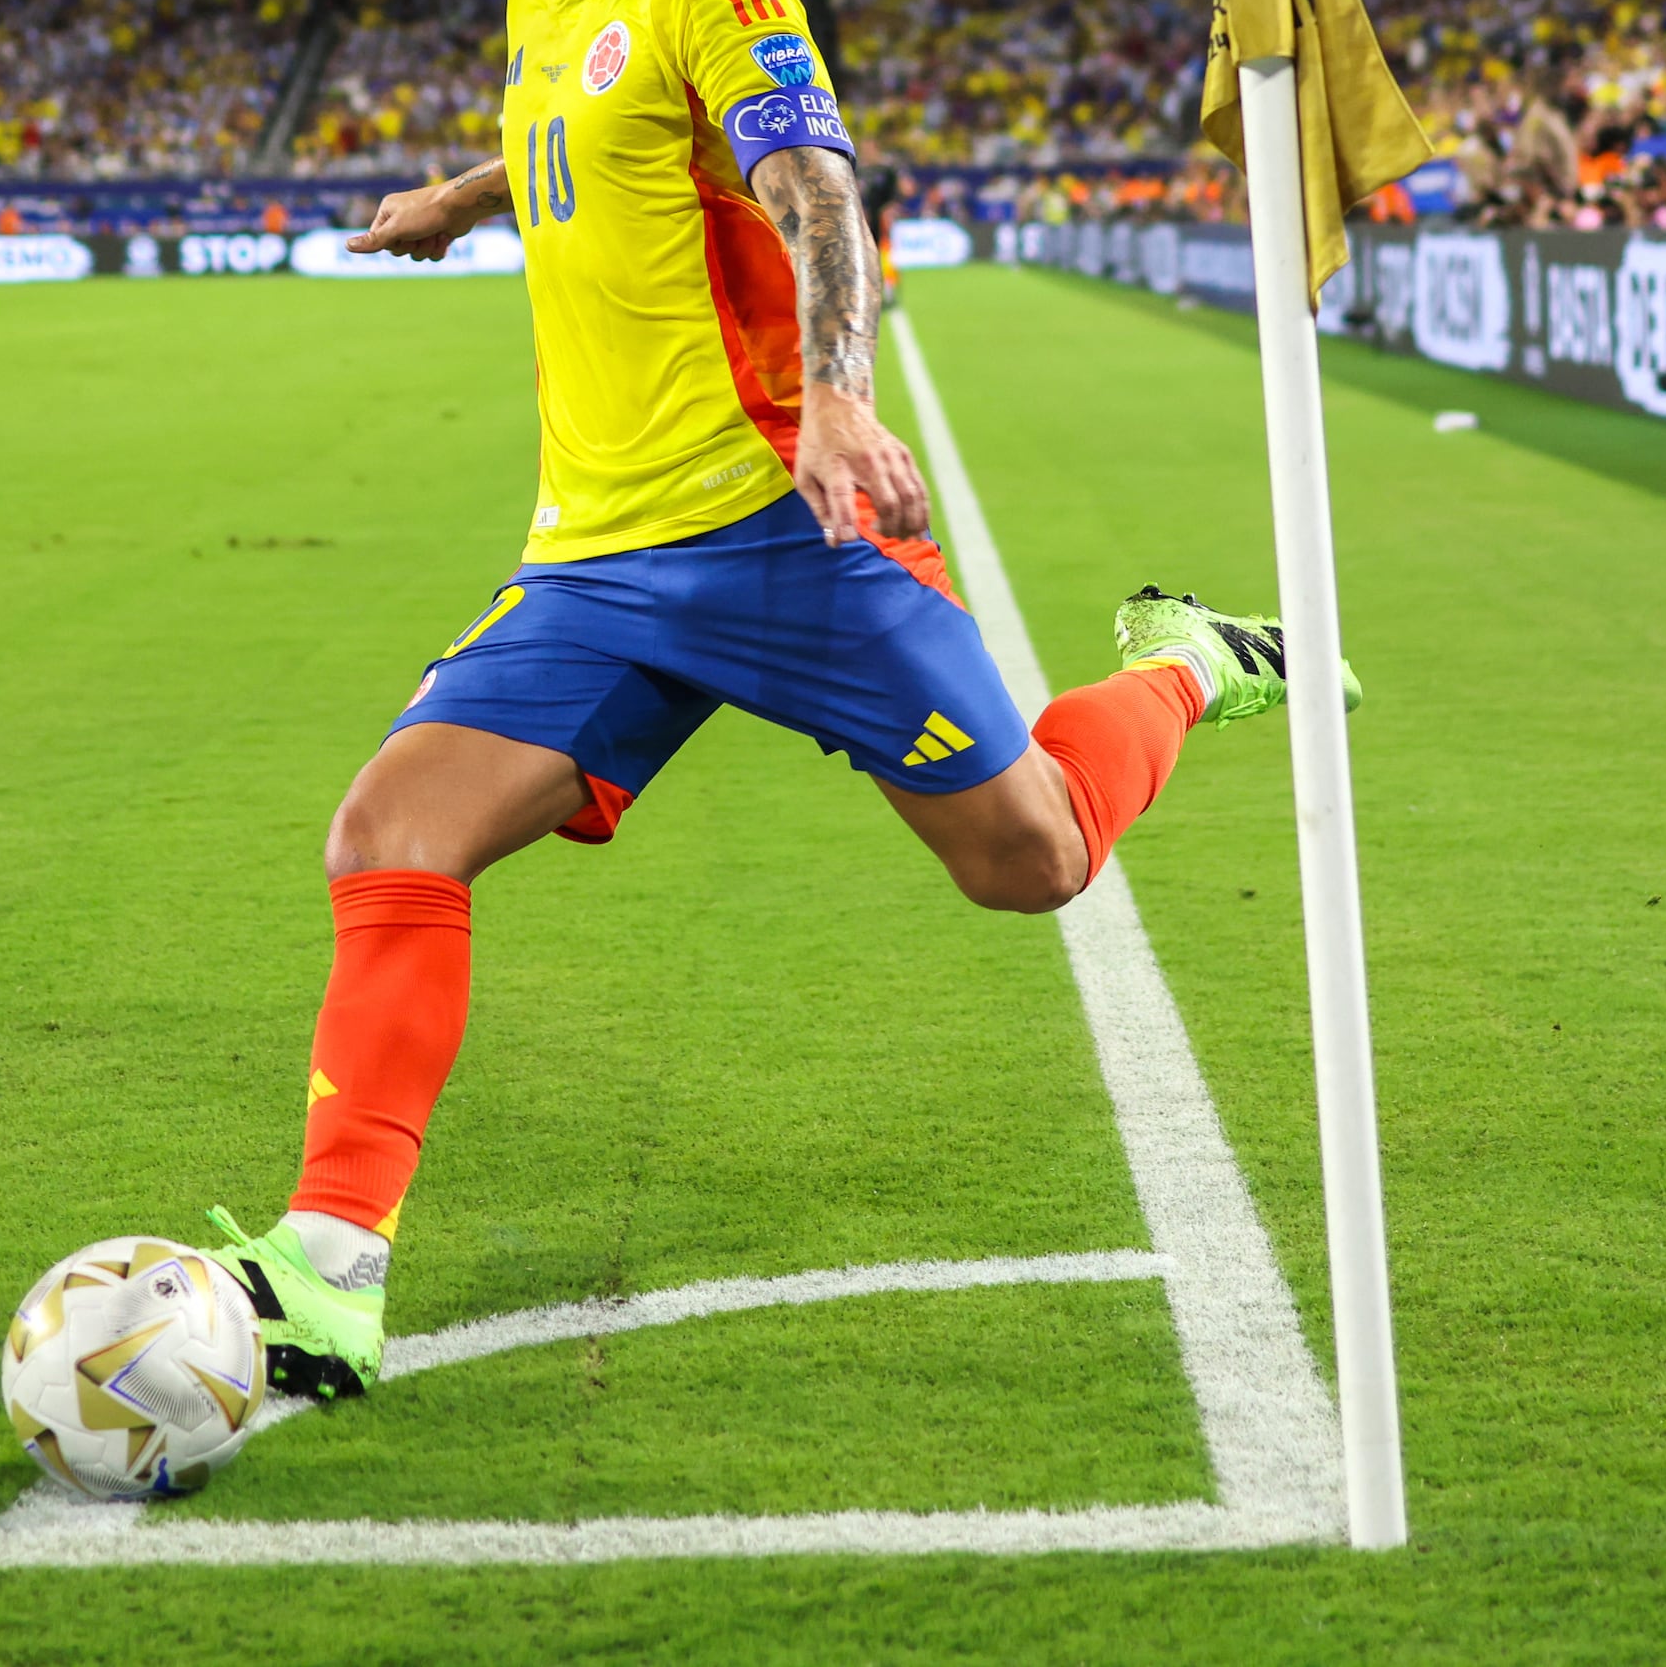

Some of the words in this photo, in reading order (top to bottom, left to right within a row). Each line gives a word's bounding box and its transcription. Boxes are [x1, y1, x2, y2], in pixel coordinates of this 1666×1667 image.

[763, 47, 806, 65] VIBRA
[799, 94, 840, 118] ELIG
[805, 116, 854, 148] INCL
[527, 116, 575, 228] 10
[180, 235, 287, 275] STOP
[1632, 273, 1657, 369] DE
